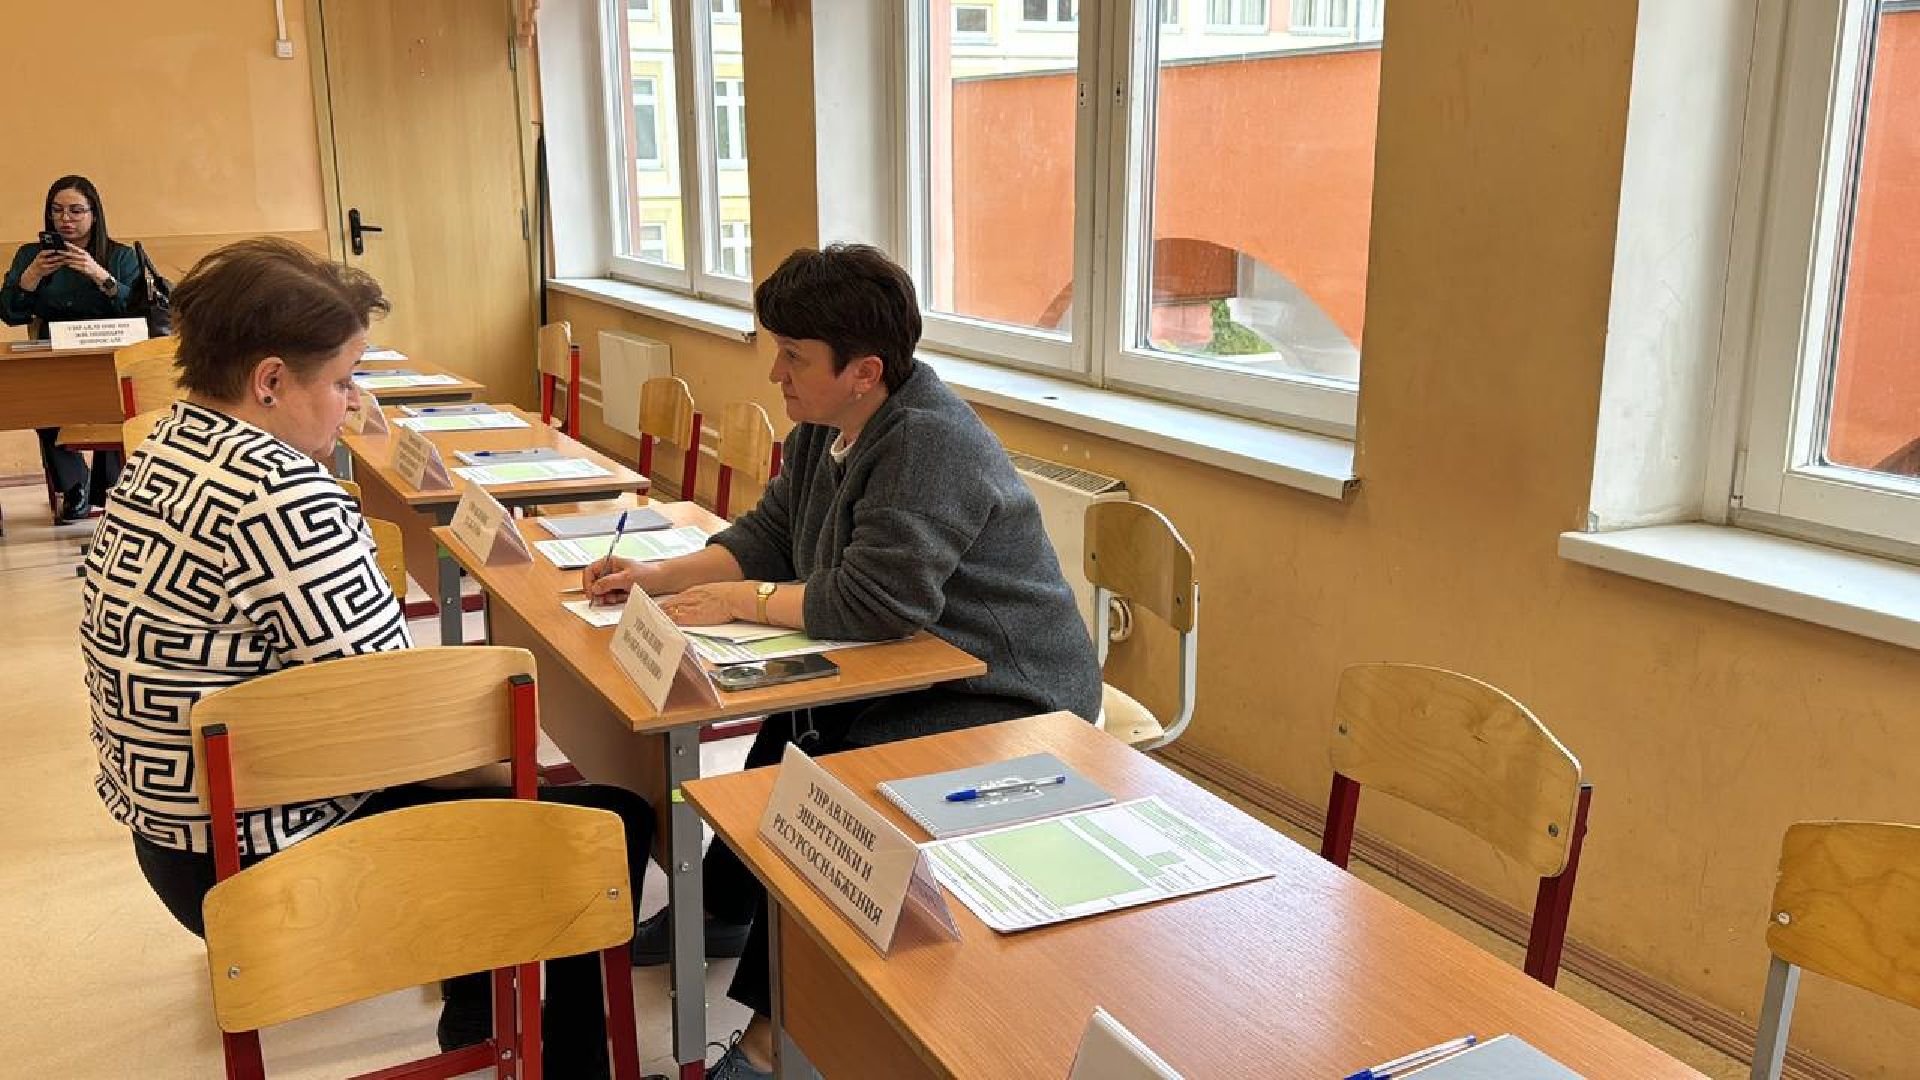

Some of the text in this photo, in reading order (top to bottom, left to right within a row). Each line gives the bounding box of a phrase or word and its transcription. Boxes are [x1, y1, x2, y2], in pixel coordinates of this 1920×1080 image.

[797, 803, 872, 882] ЭНЕРГЕТИКИ И
[808, 782, 877, 852] УПРАВЛЕНИЕ
[773, 812, 883, 926] РЕСУРСОСНАБЖЕНИЯ
